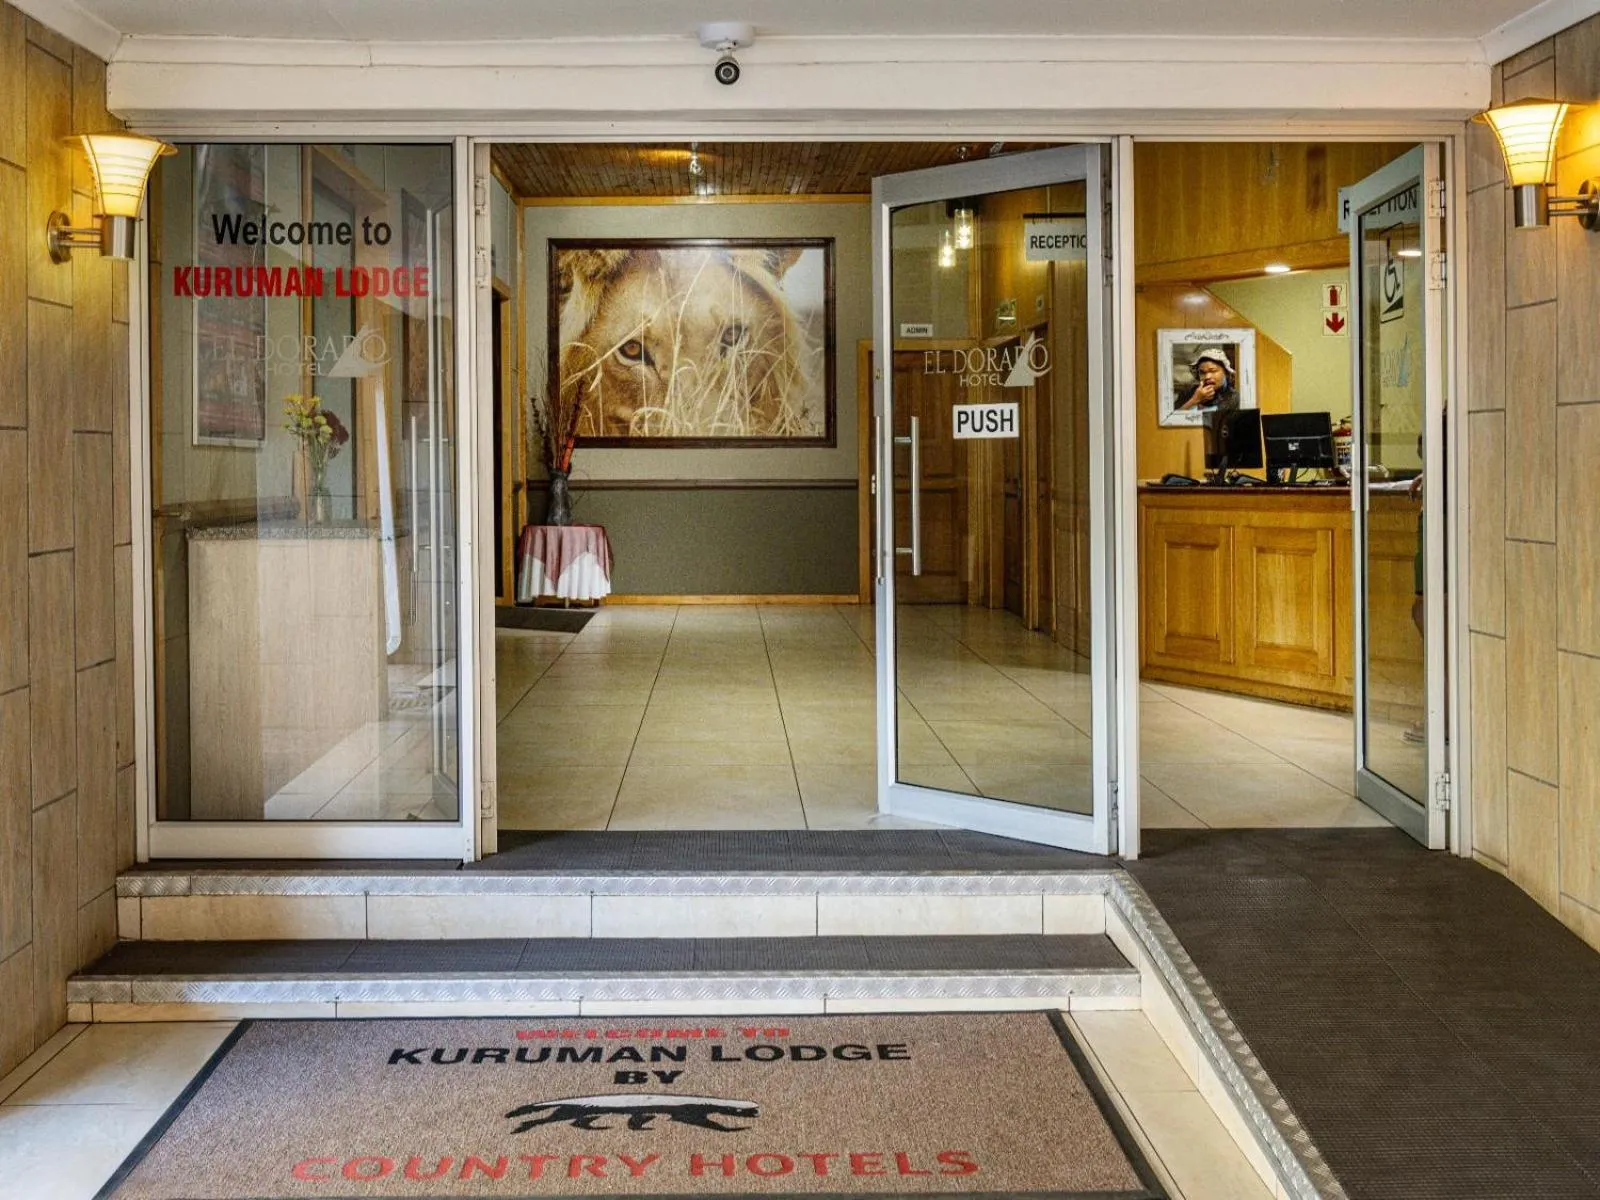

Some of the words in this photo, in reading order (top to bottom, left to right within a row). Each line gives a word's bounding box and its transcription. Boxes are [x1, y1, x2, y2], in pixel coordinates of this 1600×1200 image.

[212, 213, 352, 245] Welcome
[362, 215, 392, 245] to
[173, 266, 323, 297] KURUMAN
[335, 266, 430, 297] LODGE
[906, 326, 928, 334] ADMIN
[924, 350, 946, 375] EL
[959, 373, 1006, 387] HOTEL
[957, 409, 1014, 433] PUSH
[516, 1027, 725, 1040] WELCOME
[387, 1045, 687, 1064] KURUMAN
[710, 1044, 911, 1062] LODGE
[613, 1070, 683, 1084] BY
[292, 1153, 659, 1181] COUNTRY
[689, 1150, 979, 1177] HOTELS
